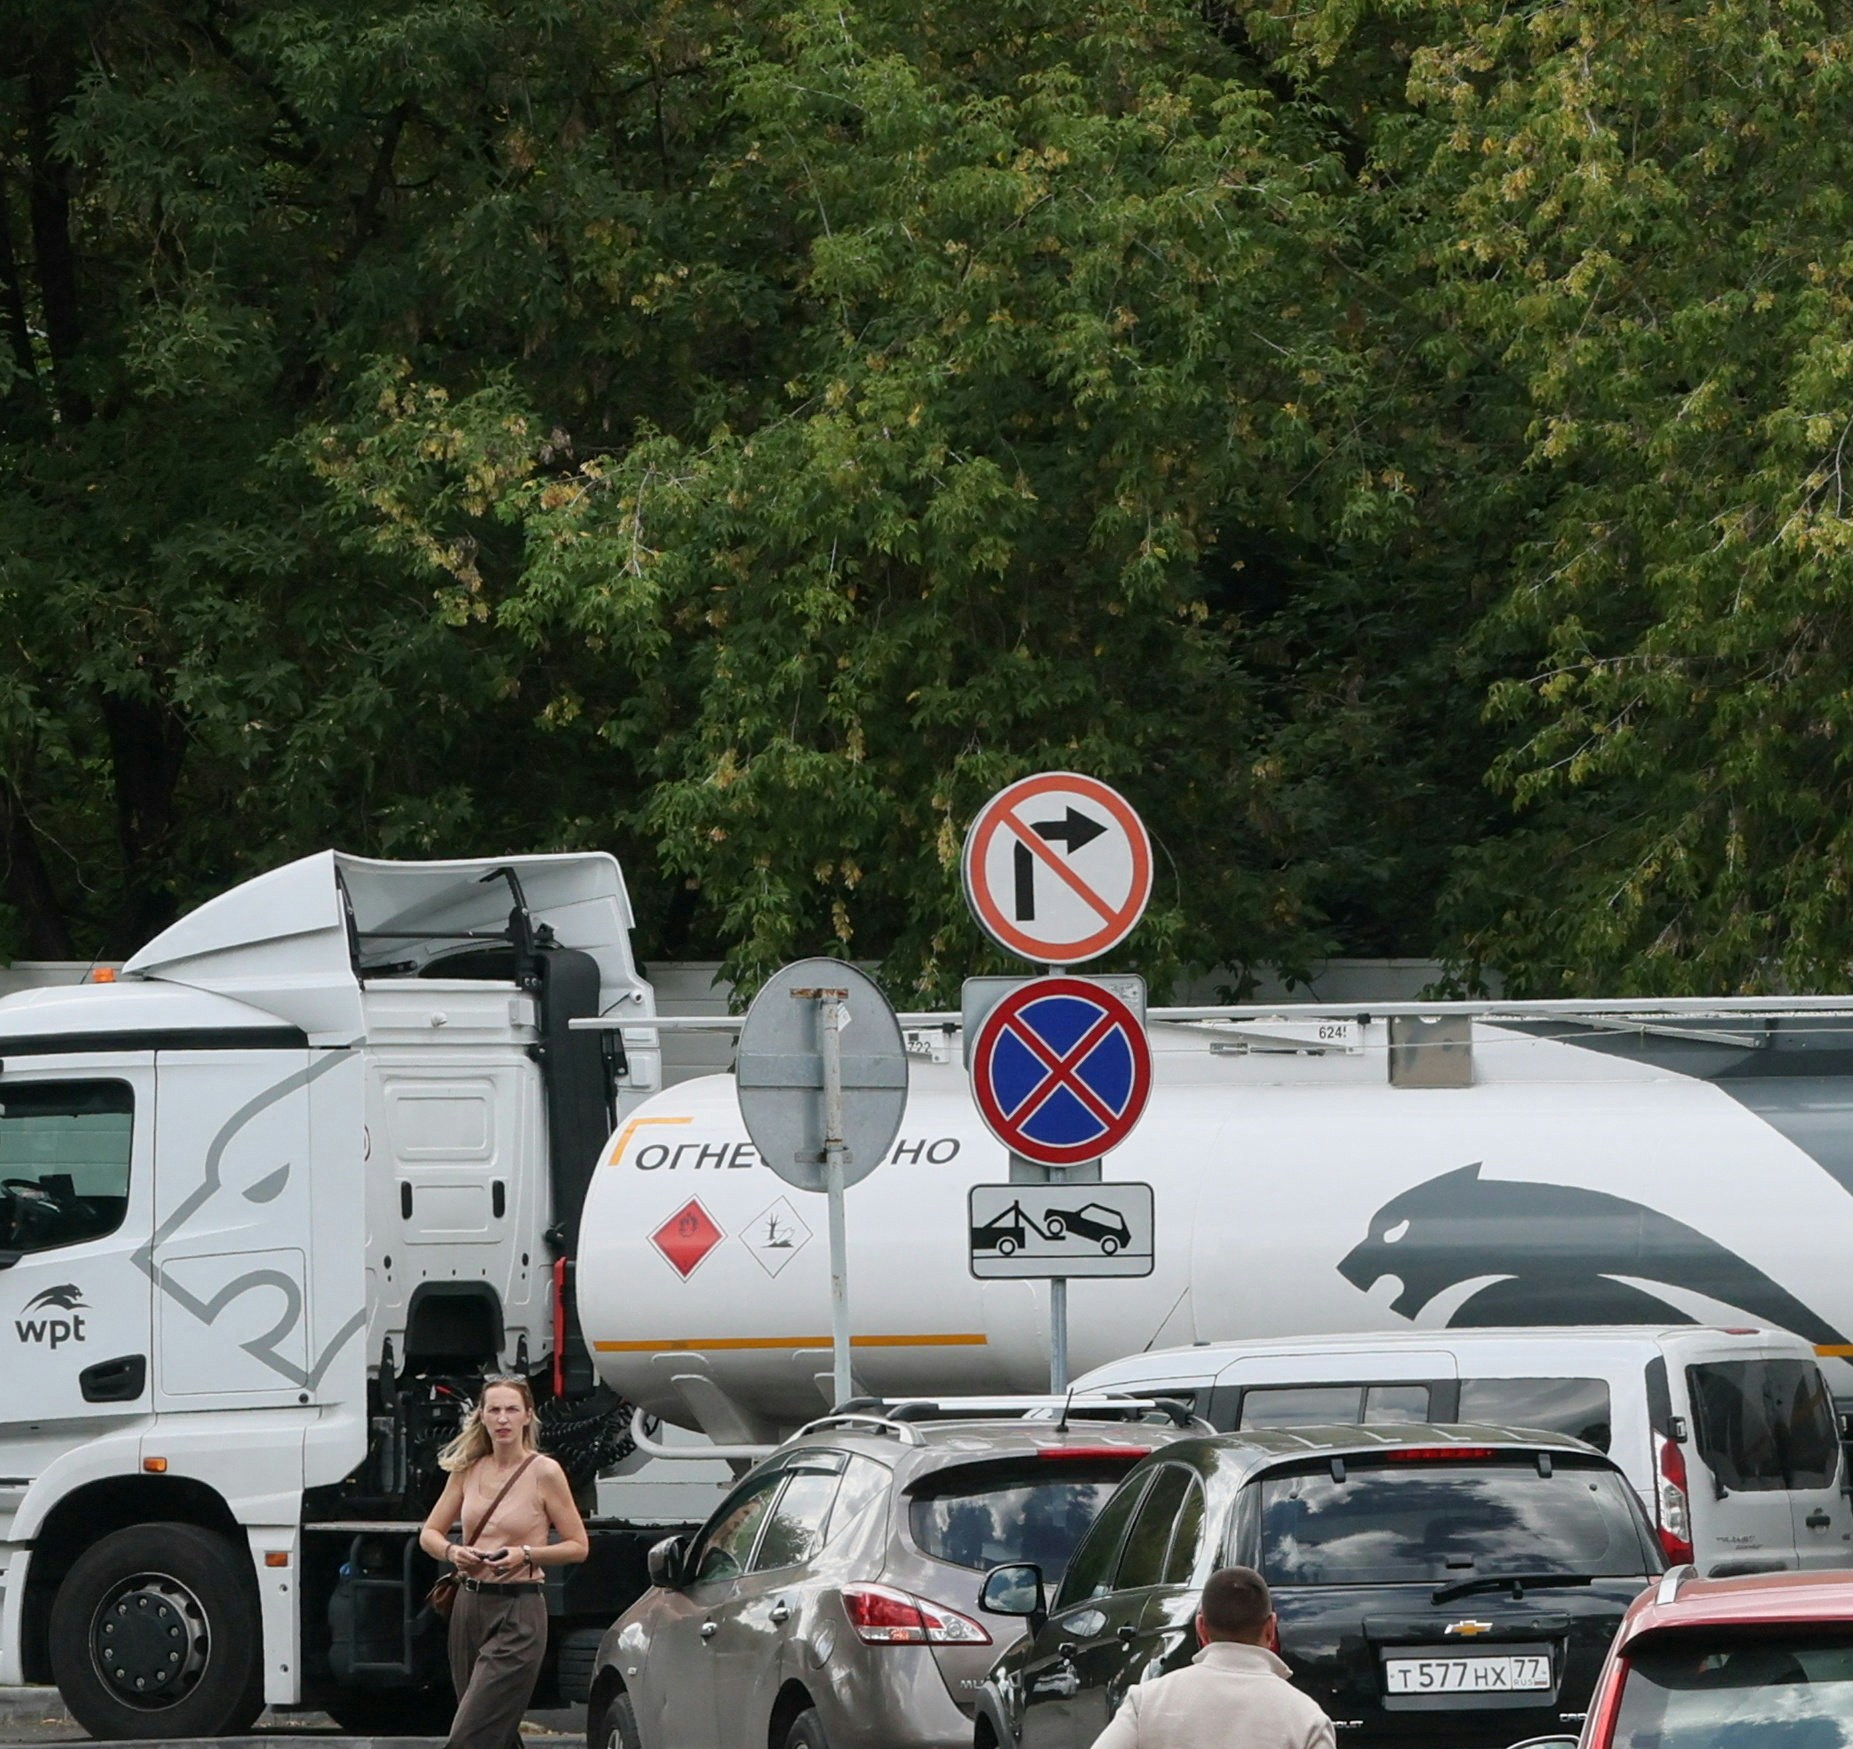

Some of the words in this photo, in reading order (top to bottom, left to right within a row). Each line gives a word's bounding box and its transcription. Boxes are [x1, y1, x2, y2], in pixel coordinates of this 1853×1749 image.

[635, 1137, 961, 1171] ОГНЕНО
[14, 1314, 86, 1350] wpt
[1513, 1659, 1541, 1679] 77
[1513, 1679, 1534, 1687] RUS
